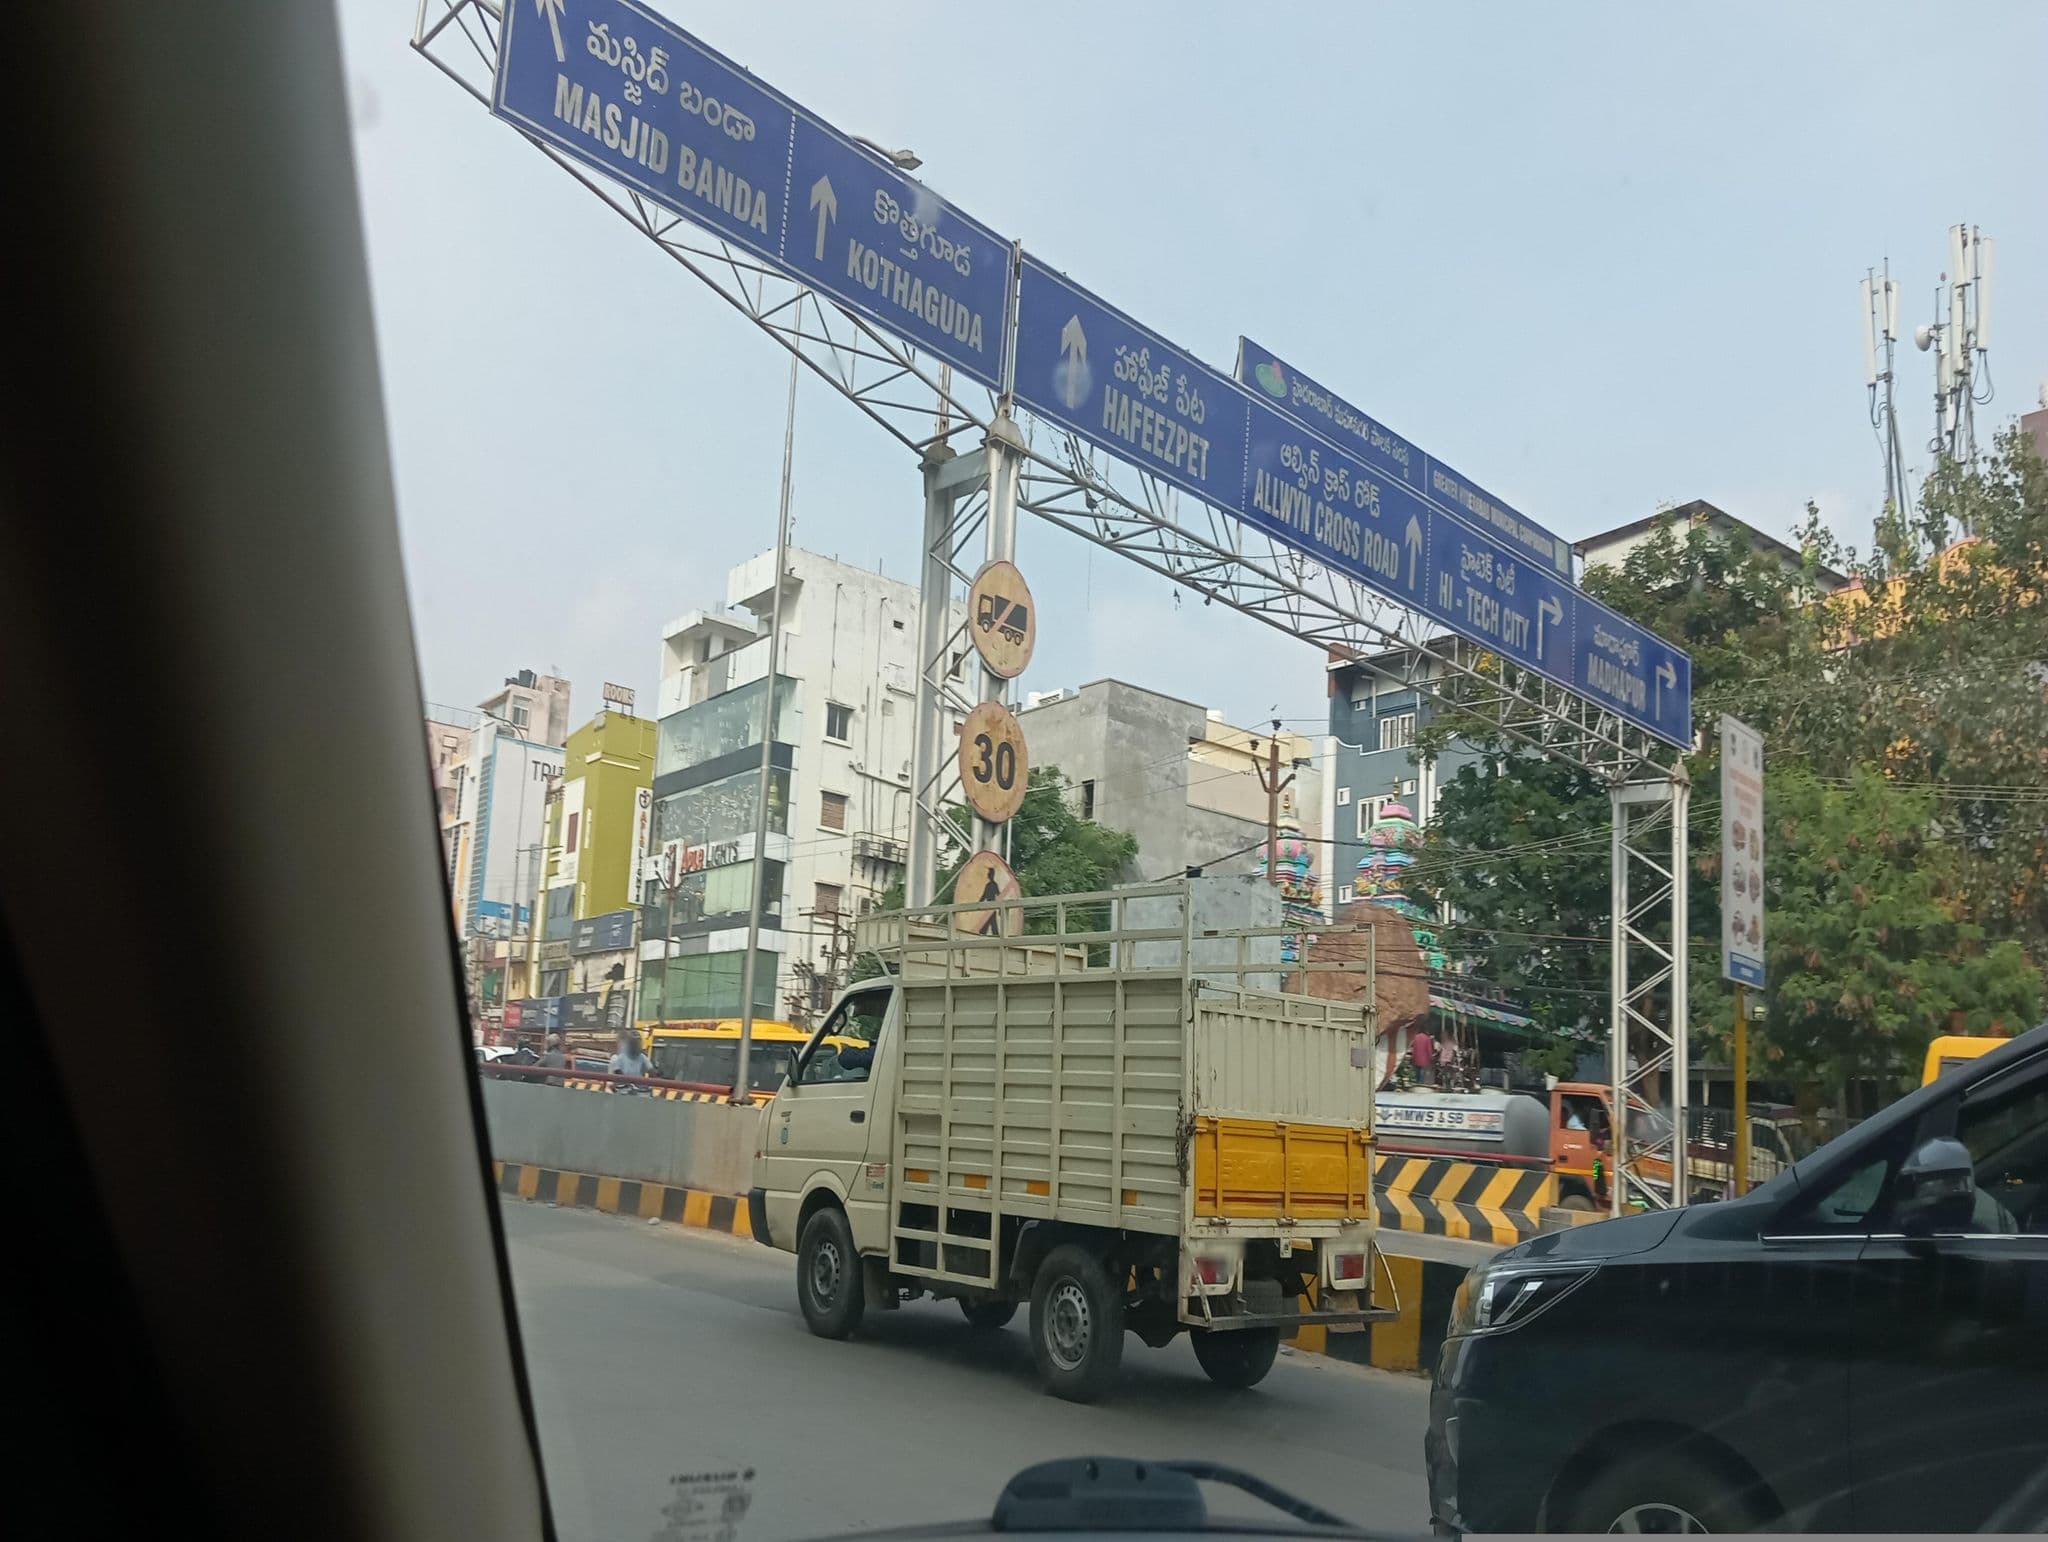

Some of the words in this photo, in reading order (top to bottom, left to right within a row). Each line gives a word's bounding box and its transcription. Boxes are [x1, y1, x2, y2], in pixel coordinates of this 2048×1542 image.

[554, 73, 668, 175] MASJID
[676, 143, 768, 235] BANDA
[679, 80, 756, 142] బండా
[873, 188, 971, 277] కొత్తగూడ
[846, 238, 983, 353] KOTHAGUDA
[1102, 384, 1210, 480] HAFEEZPET
[1176, 373, 1206, 425] పేట
[1253, 467, 1312, 536] ALLWYN
[1314, 505, 1360, 561] CROSS
[1363, 533, 1399, 581] ROAD
[1439, 571, 1453, 612] HI
[1466, 586, 1499, 637] TECH
[1503, 607, 1530, 652] CITY
[972, 732, 1017, 791] 30
